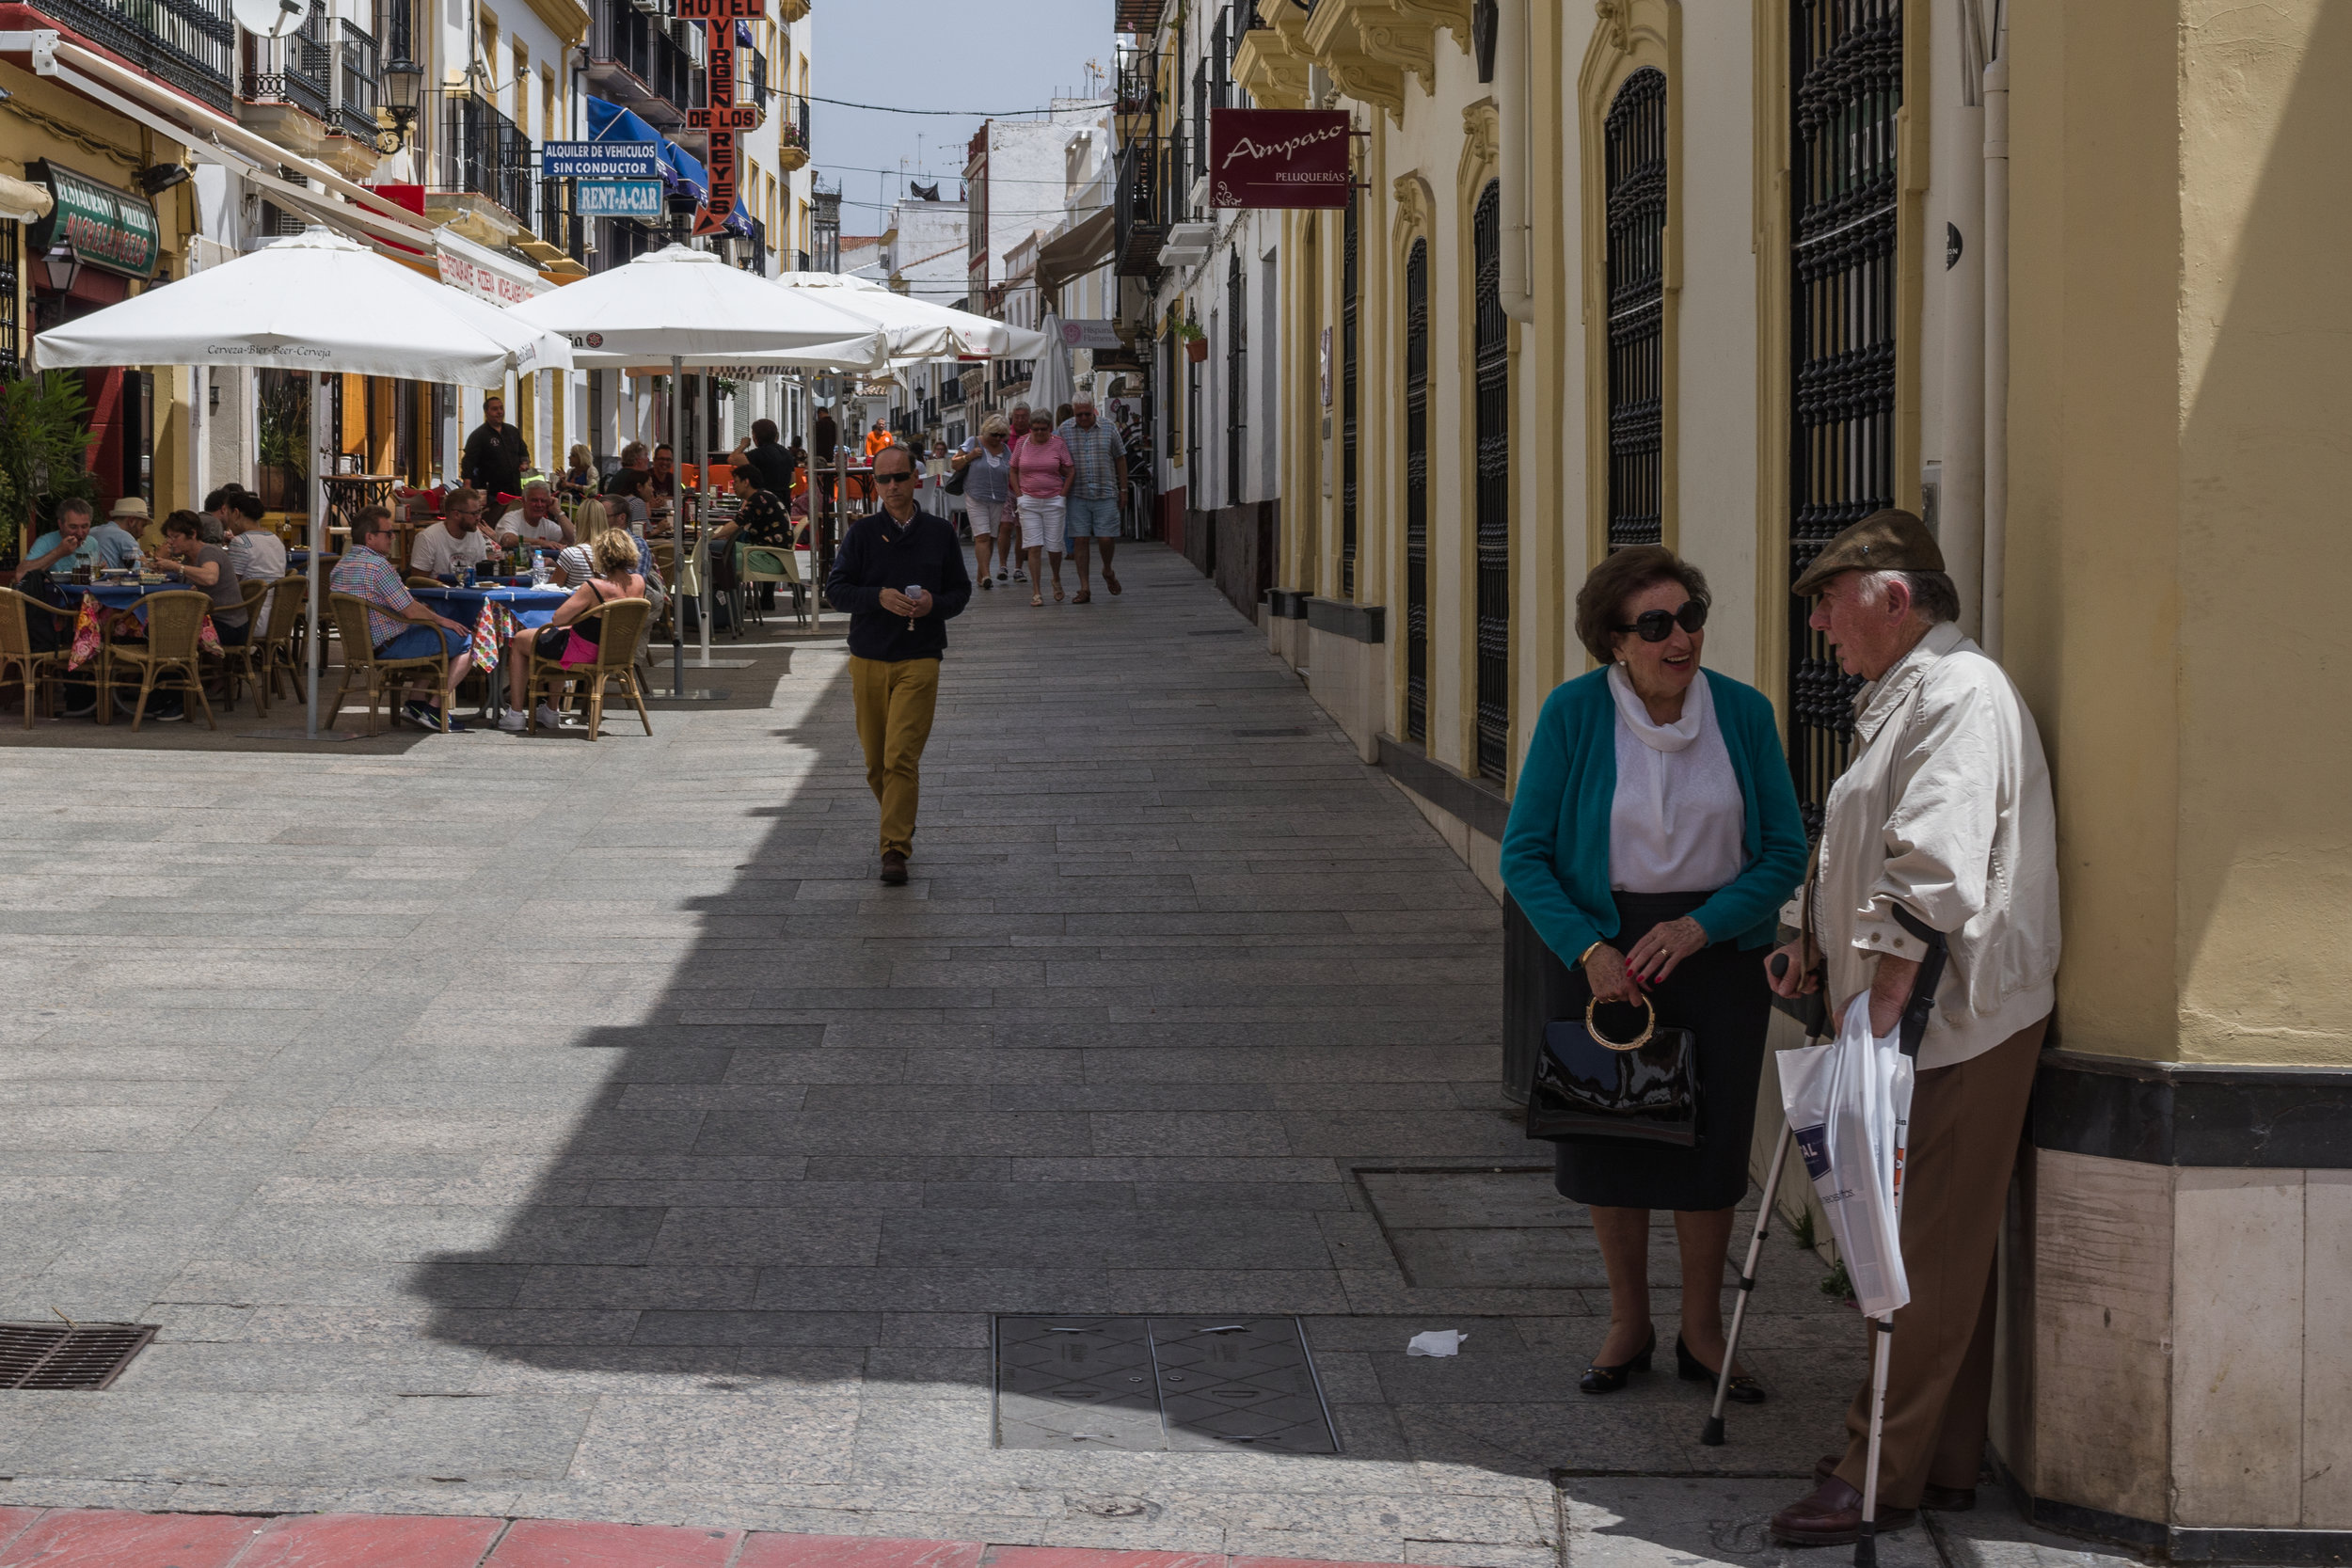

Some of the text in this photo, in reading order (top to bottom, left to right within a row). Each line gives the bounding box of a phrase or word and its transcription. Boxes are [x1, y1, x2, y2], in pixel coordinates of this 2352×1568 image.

[681, 0, 760, 16] HOTEL
[710, 19, 731, 109] VIRGEN
[689, 110, 754, 127] DE LOS
[546, 145, 655, 159] ALQUILER DE VEHICULOS
[1221, 125, 1344, 169] Amparo
[553, 162, 573, 174] SIN
[575, 162, 647, 174] CONDUCTOR
[709, 132, 732, 214] REYES
[1276, 170, 1345, 182] PELUQUERÍAS
[54, 172, 119, 221] RESTAURANTE
[581, 187, 658, 210] RENT-A-CAR
[66, 212, 148, 267] MICHELANGELO
